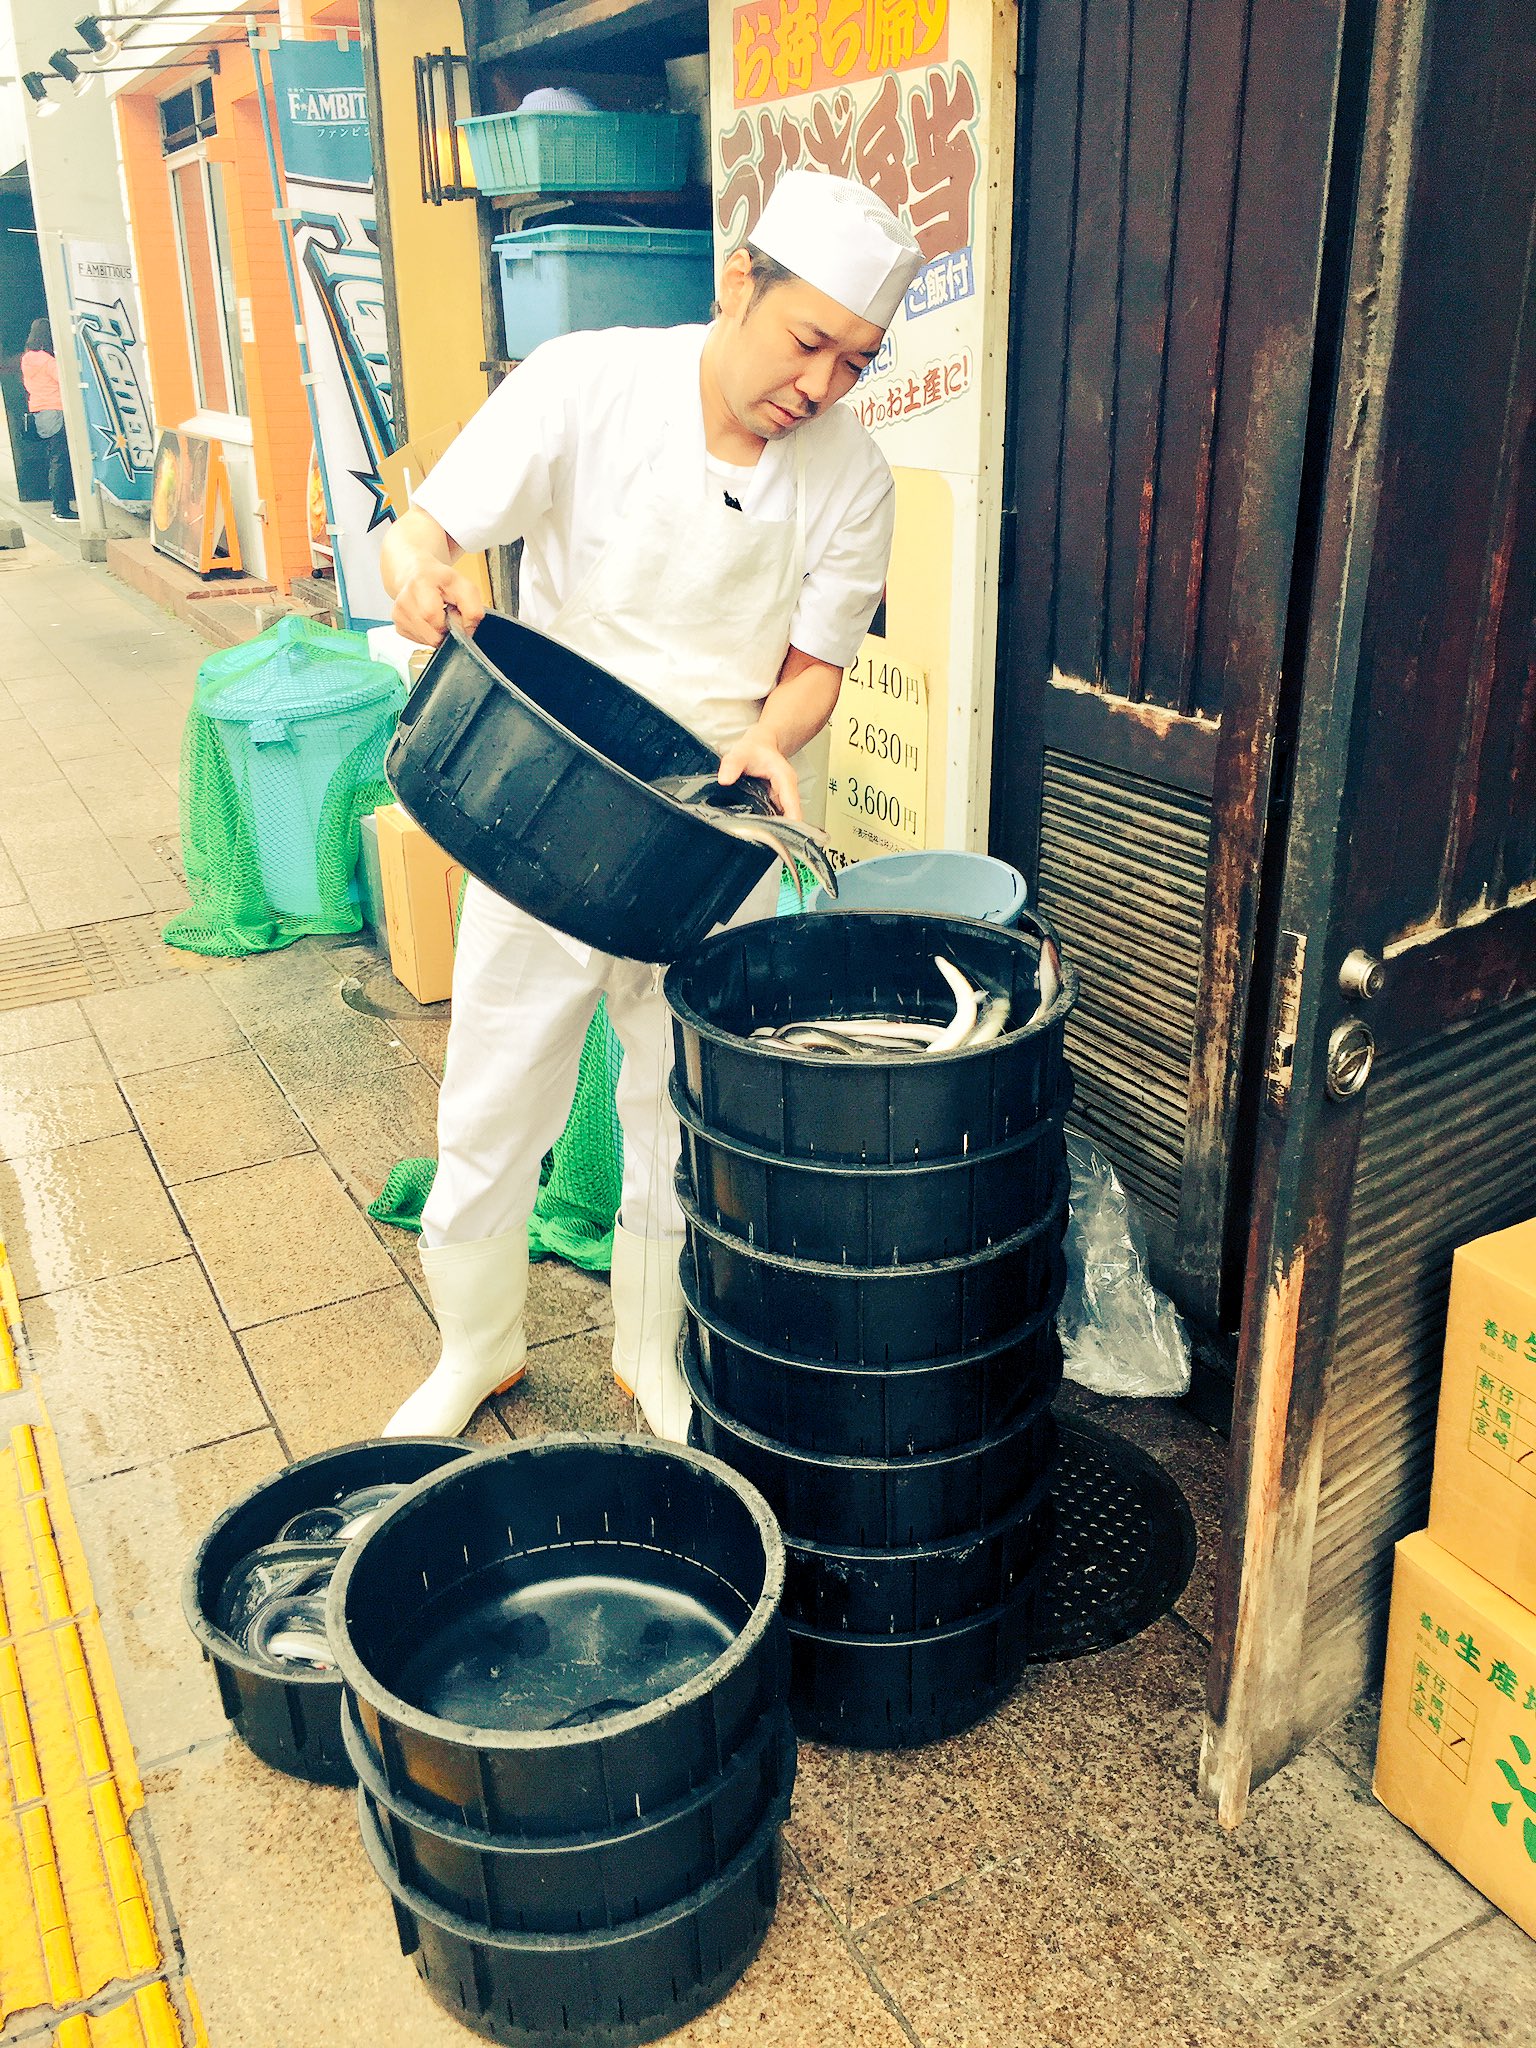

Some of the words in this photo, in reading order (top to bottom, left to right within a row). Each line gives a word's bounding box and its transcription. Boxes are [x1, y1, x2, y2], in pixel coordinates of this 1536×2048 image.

[734, 0, 947, 100] お持ち帰り
[908, 252, 970, 314] ご飯付
[858, 336, 893, 383] に!
[853, 354, 970, 428] けのお土産に!
[848, 655, 919, 706] 2,140円
[848, 716, 918, 772] 2,630円
[847, 777, 917, 836] 3,600円
[1477, 1395, 1512, 1430] 大隅
[1479, 1373, 1515, 1406] 新仔
[1474, 1416, 1509, 1451] 宮崎
[1416, 1660, 1447, 1695] 新仔
